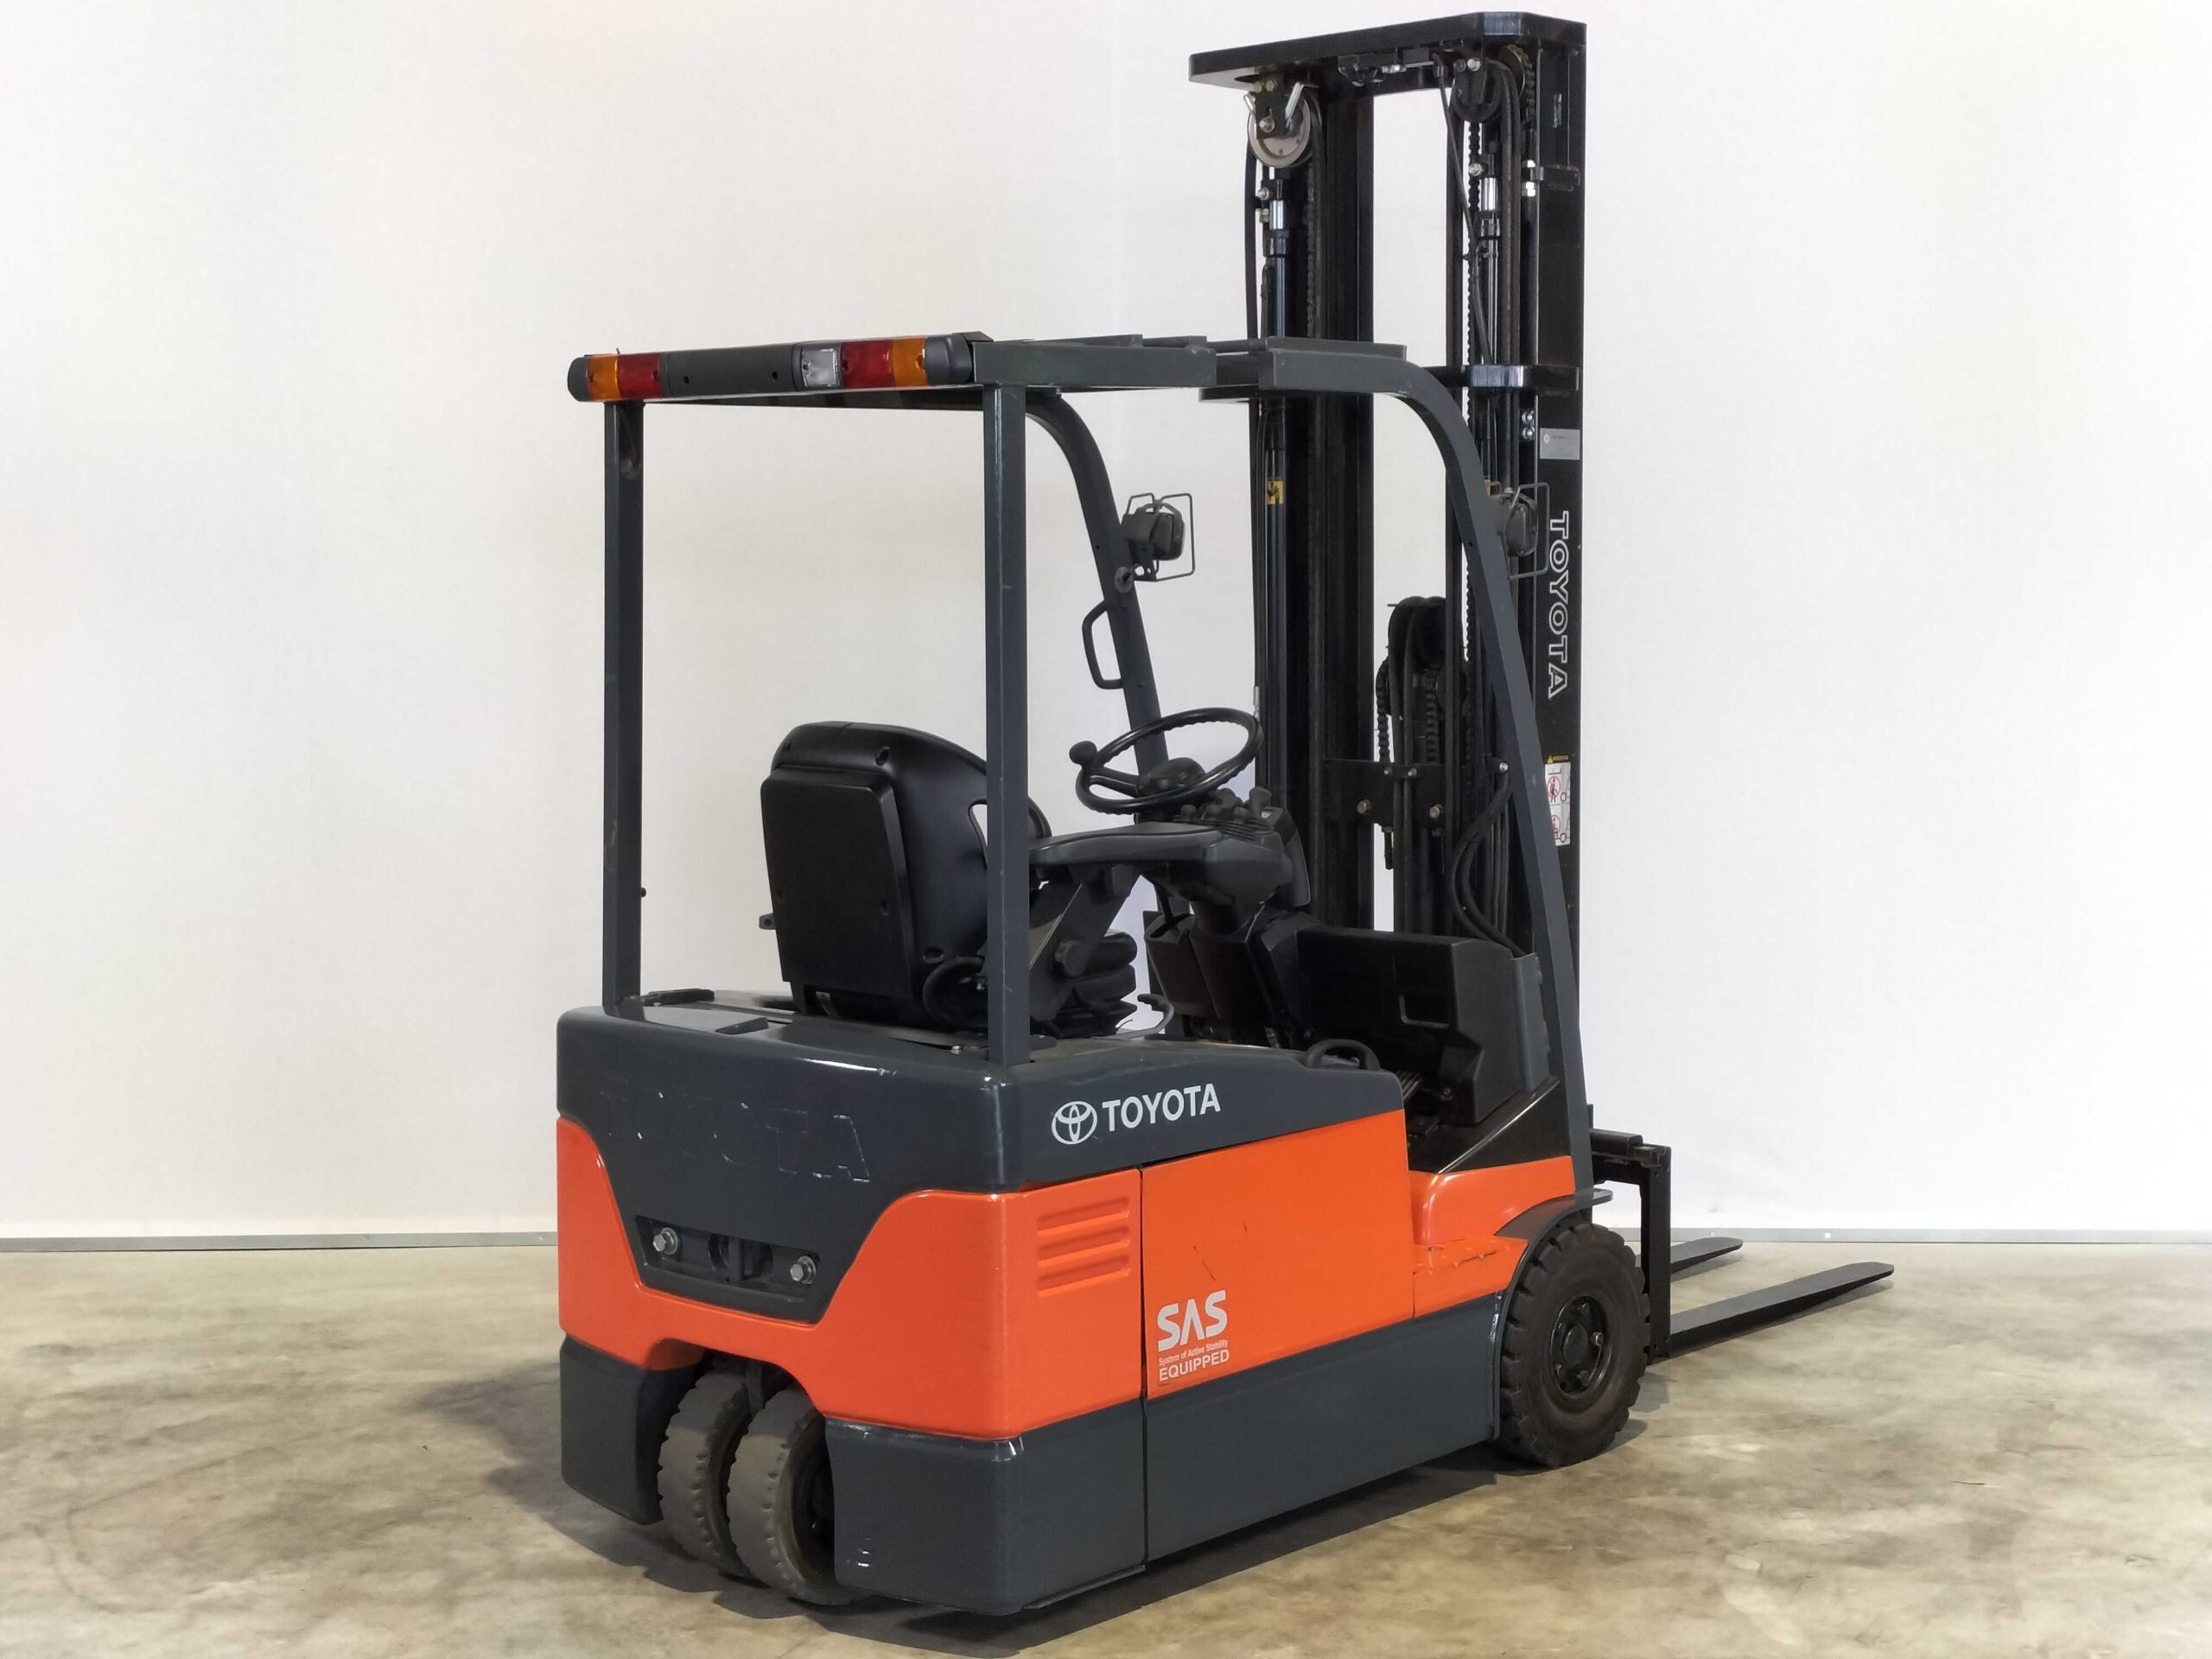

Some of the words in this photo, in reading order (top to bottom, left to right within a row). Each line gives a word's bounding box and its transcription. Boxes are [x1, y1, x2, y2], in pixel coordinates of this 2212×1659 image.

[1548, 511, 1569, 698] TOYOTA
[1103, 1084, 1221, 1132] TOYOTA
[1157, 1290, 1228, 1352] SAS
[1159, 1349, 1230, 1382] EQUIPPED
[1180, 1350, 1187, 1359] of
